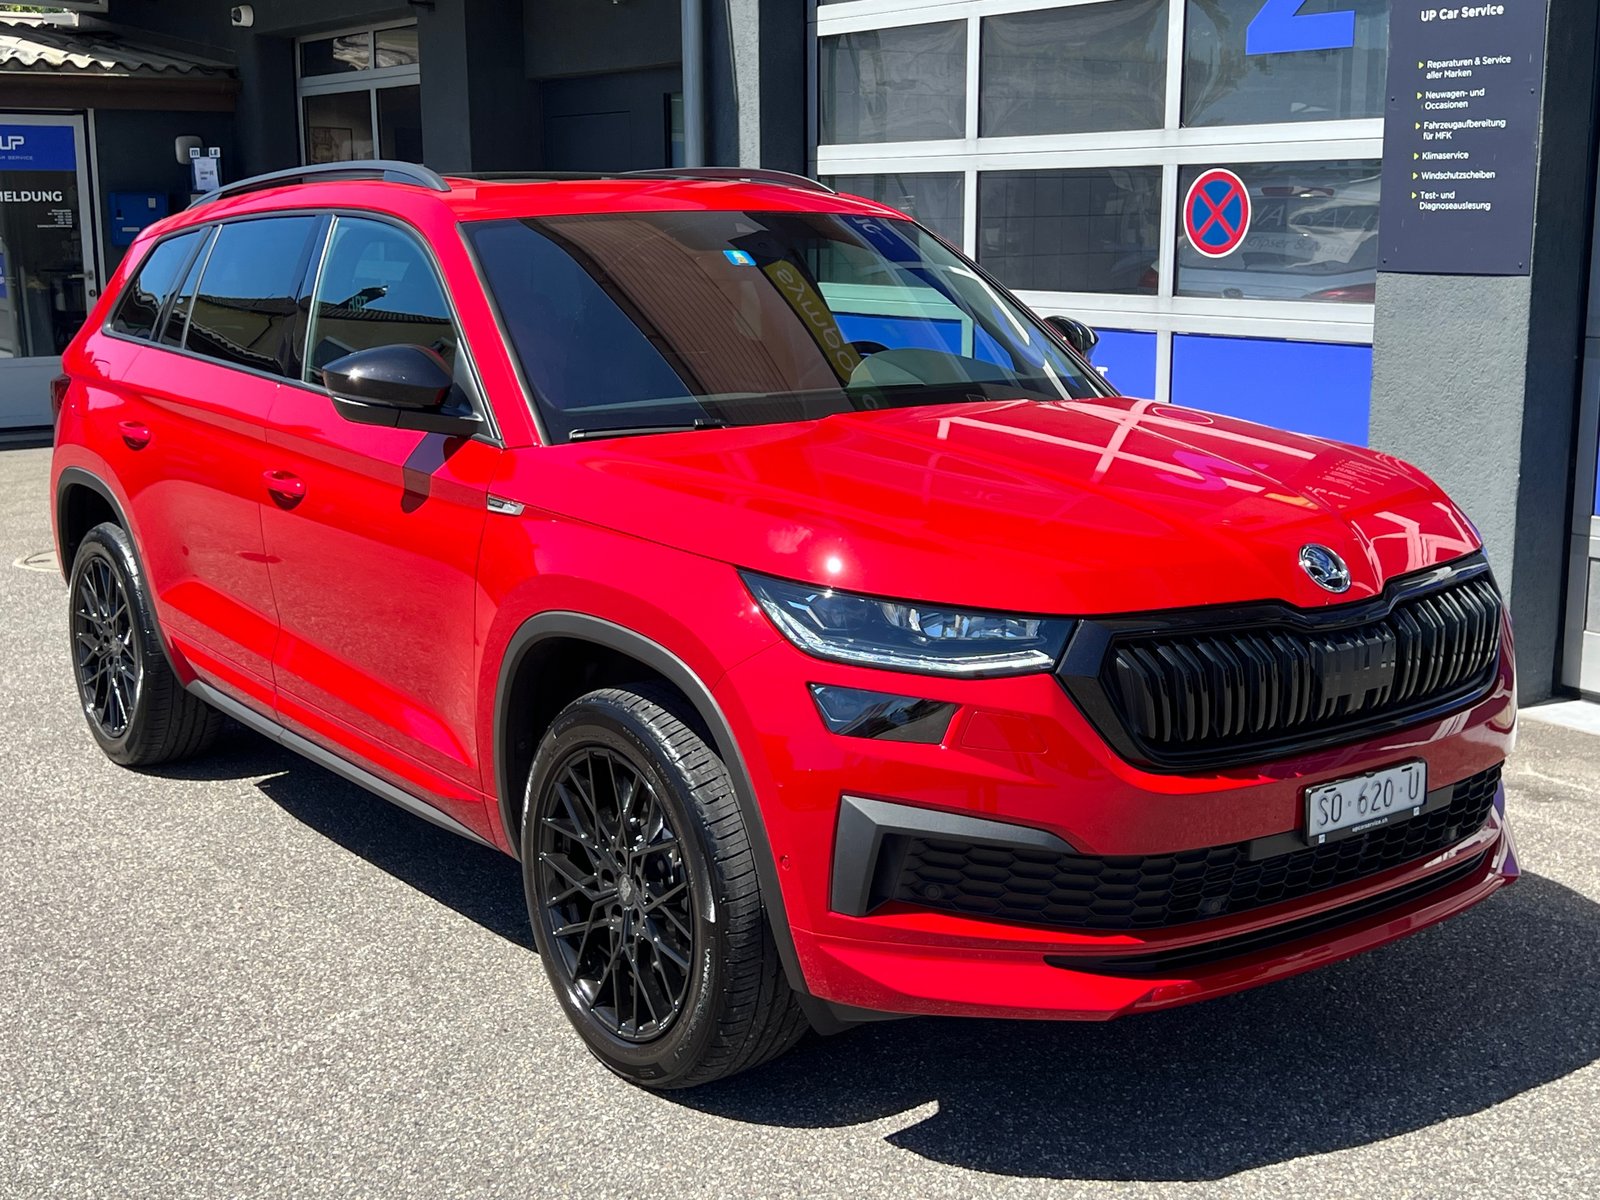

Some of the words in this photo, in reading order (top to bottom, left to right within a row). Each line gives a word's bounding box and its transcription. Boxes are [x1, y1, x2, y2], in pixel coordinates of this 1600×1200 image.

[1421, 10, 1437, 21] UP
[1439, 8, 1459, 20] Car
[1461, 4, 1504, 18] Service
[1427, 59, 1473, 69] Reparaturen
[1474, 57, 1480, 65] &
[1482, 55, 1511, 65] Service
[1426, 71, 1442, 79] aller
[1444, 69, 1472, 78] Marken
[1425, 90, 1468, 99] Neuwagen-
[1470, 88, 1485, 97] und
[1425, 100, 1468, 110] Occasionen
[1424, 119, 1506, 130] Fahrzeugaufbereitung
[1423, 131, 1434, 140] für
[1435, 131, 1452, 140] MFK
[1422, 151, 1469, 160] Klimaservice
[1421, 170, 1496, 180] Windschutzscheiben
[1420, 191, 1439, 199] Test-
[1440, 191, 1455, 199] und
[1419, 202, 1491, 211] Diagnoseauslesung
